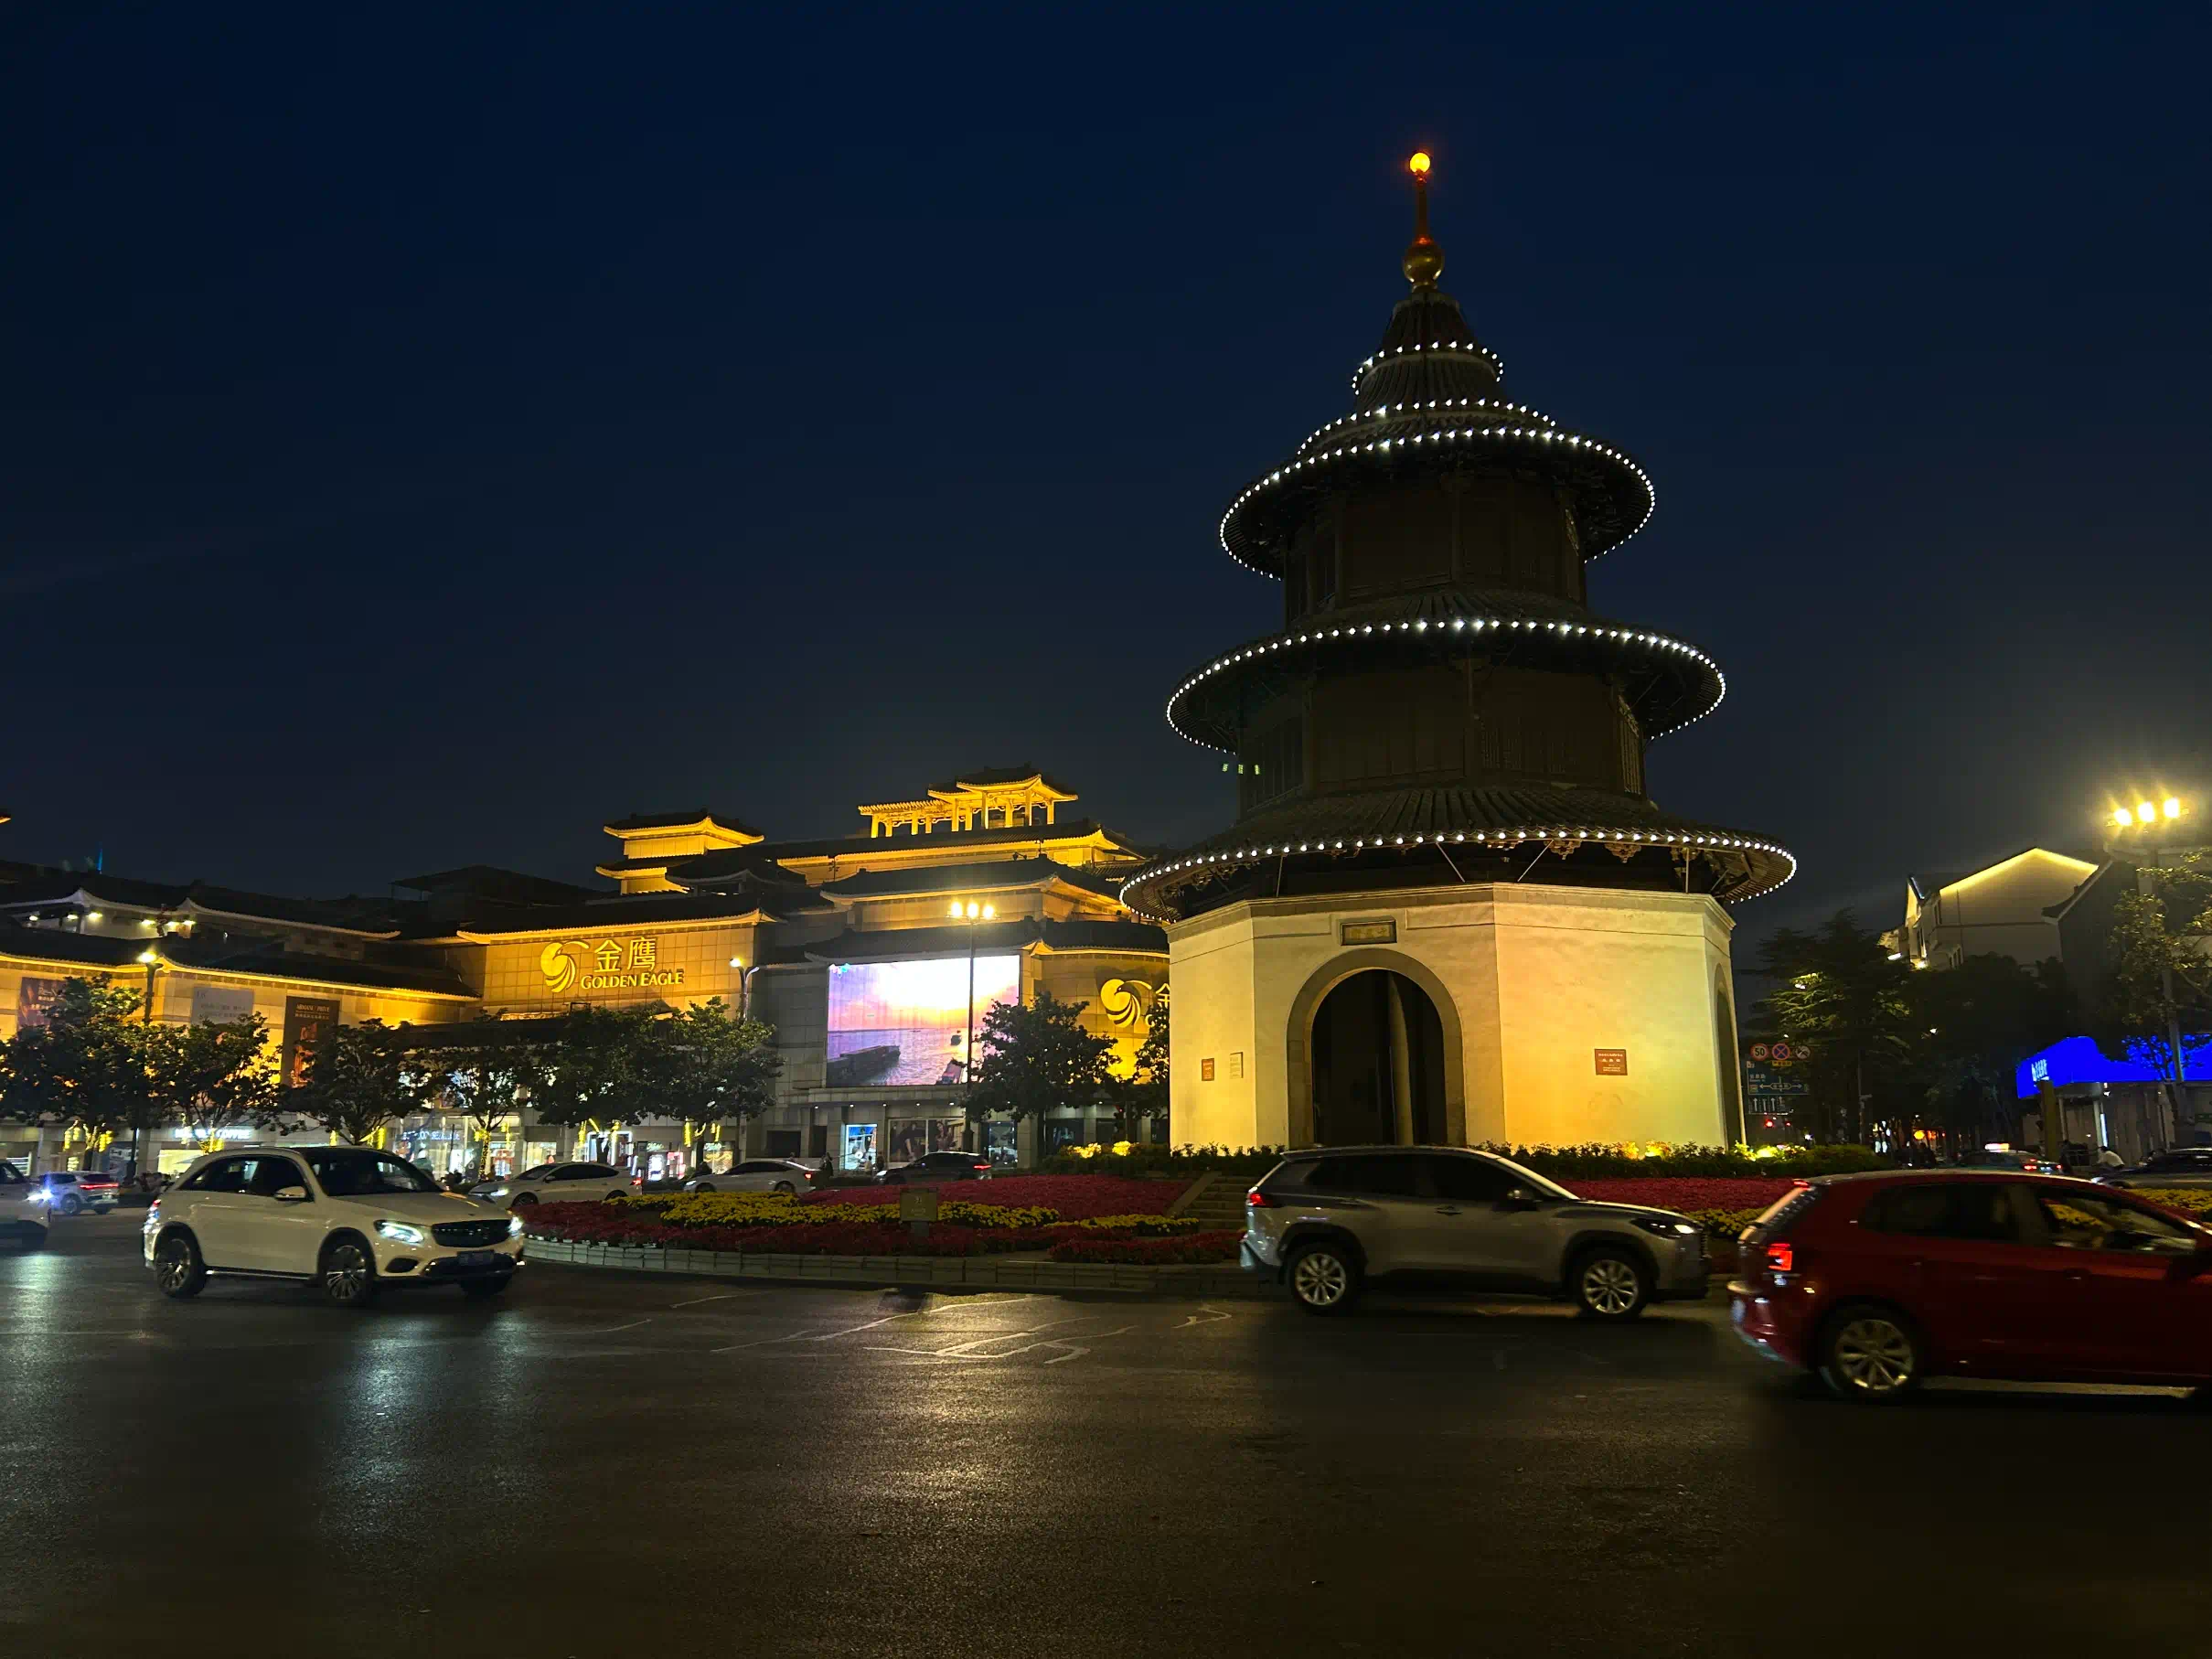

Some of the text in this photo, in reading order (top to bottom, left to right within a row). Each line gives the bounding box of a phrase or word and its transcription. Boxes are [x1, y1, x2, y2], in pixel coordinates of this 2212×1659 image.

[593, 937, 657, 972] 金鹰
[581, 971, 685, 989] GOLDEN EAGLE
[1755, 1047, 1766, 1056] 50
